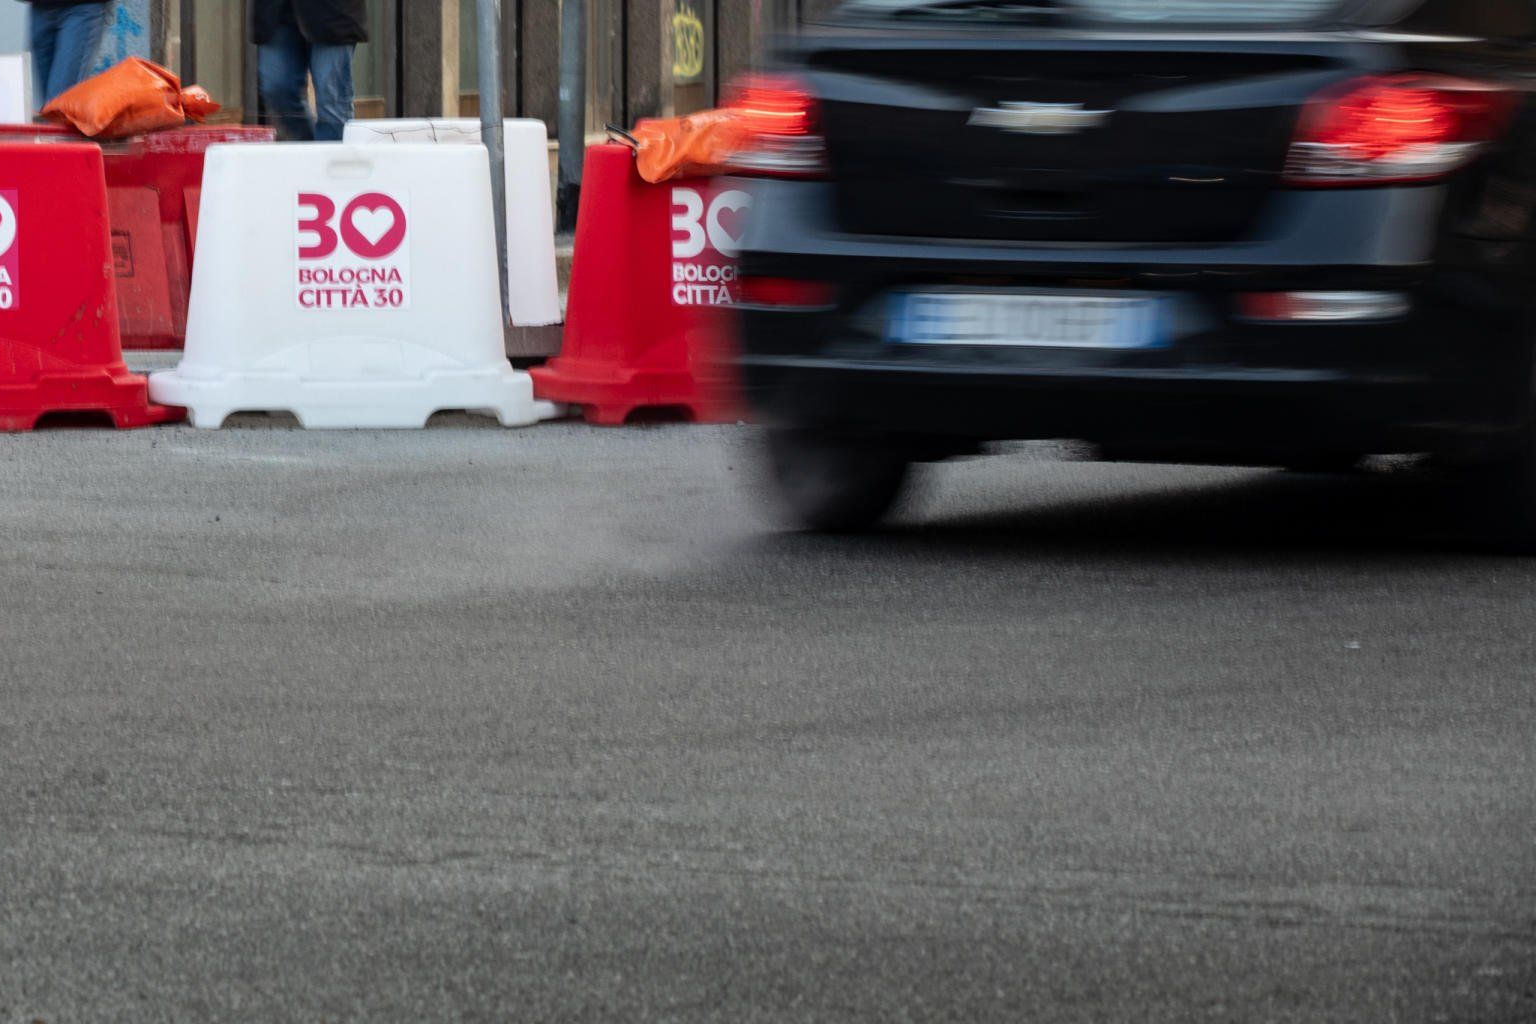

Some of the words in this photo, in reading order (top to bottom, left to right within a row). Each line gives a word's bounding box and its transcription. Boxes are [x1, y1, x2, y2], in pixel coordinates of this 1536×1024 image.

[298, 191, 406, 259] 30
[298, 267, 402, 284] BOLOGNA
[672, 261, 738, 283] BOLOG
[298, 282, 369, 308] CITTÀ
[373, 287, 403, 307] 30
[672, 281, 733, 305] CITTÀ
